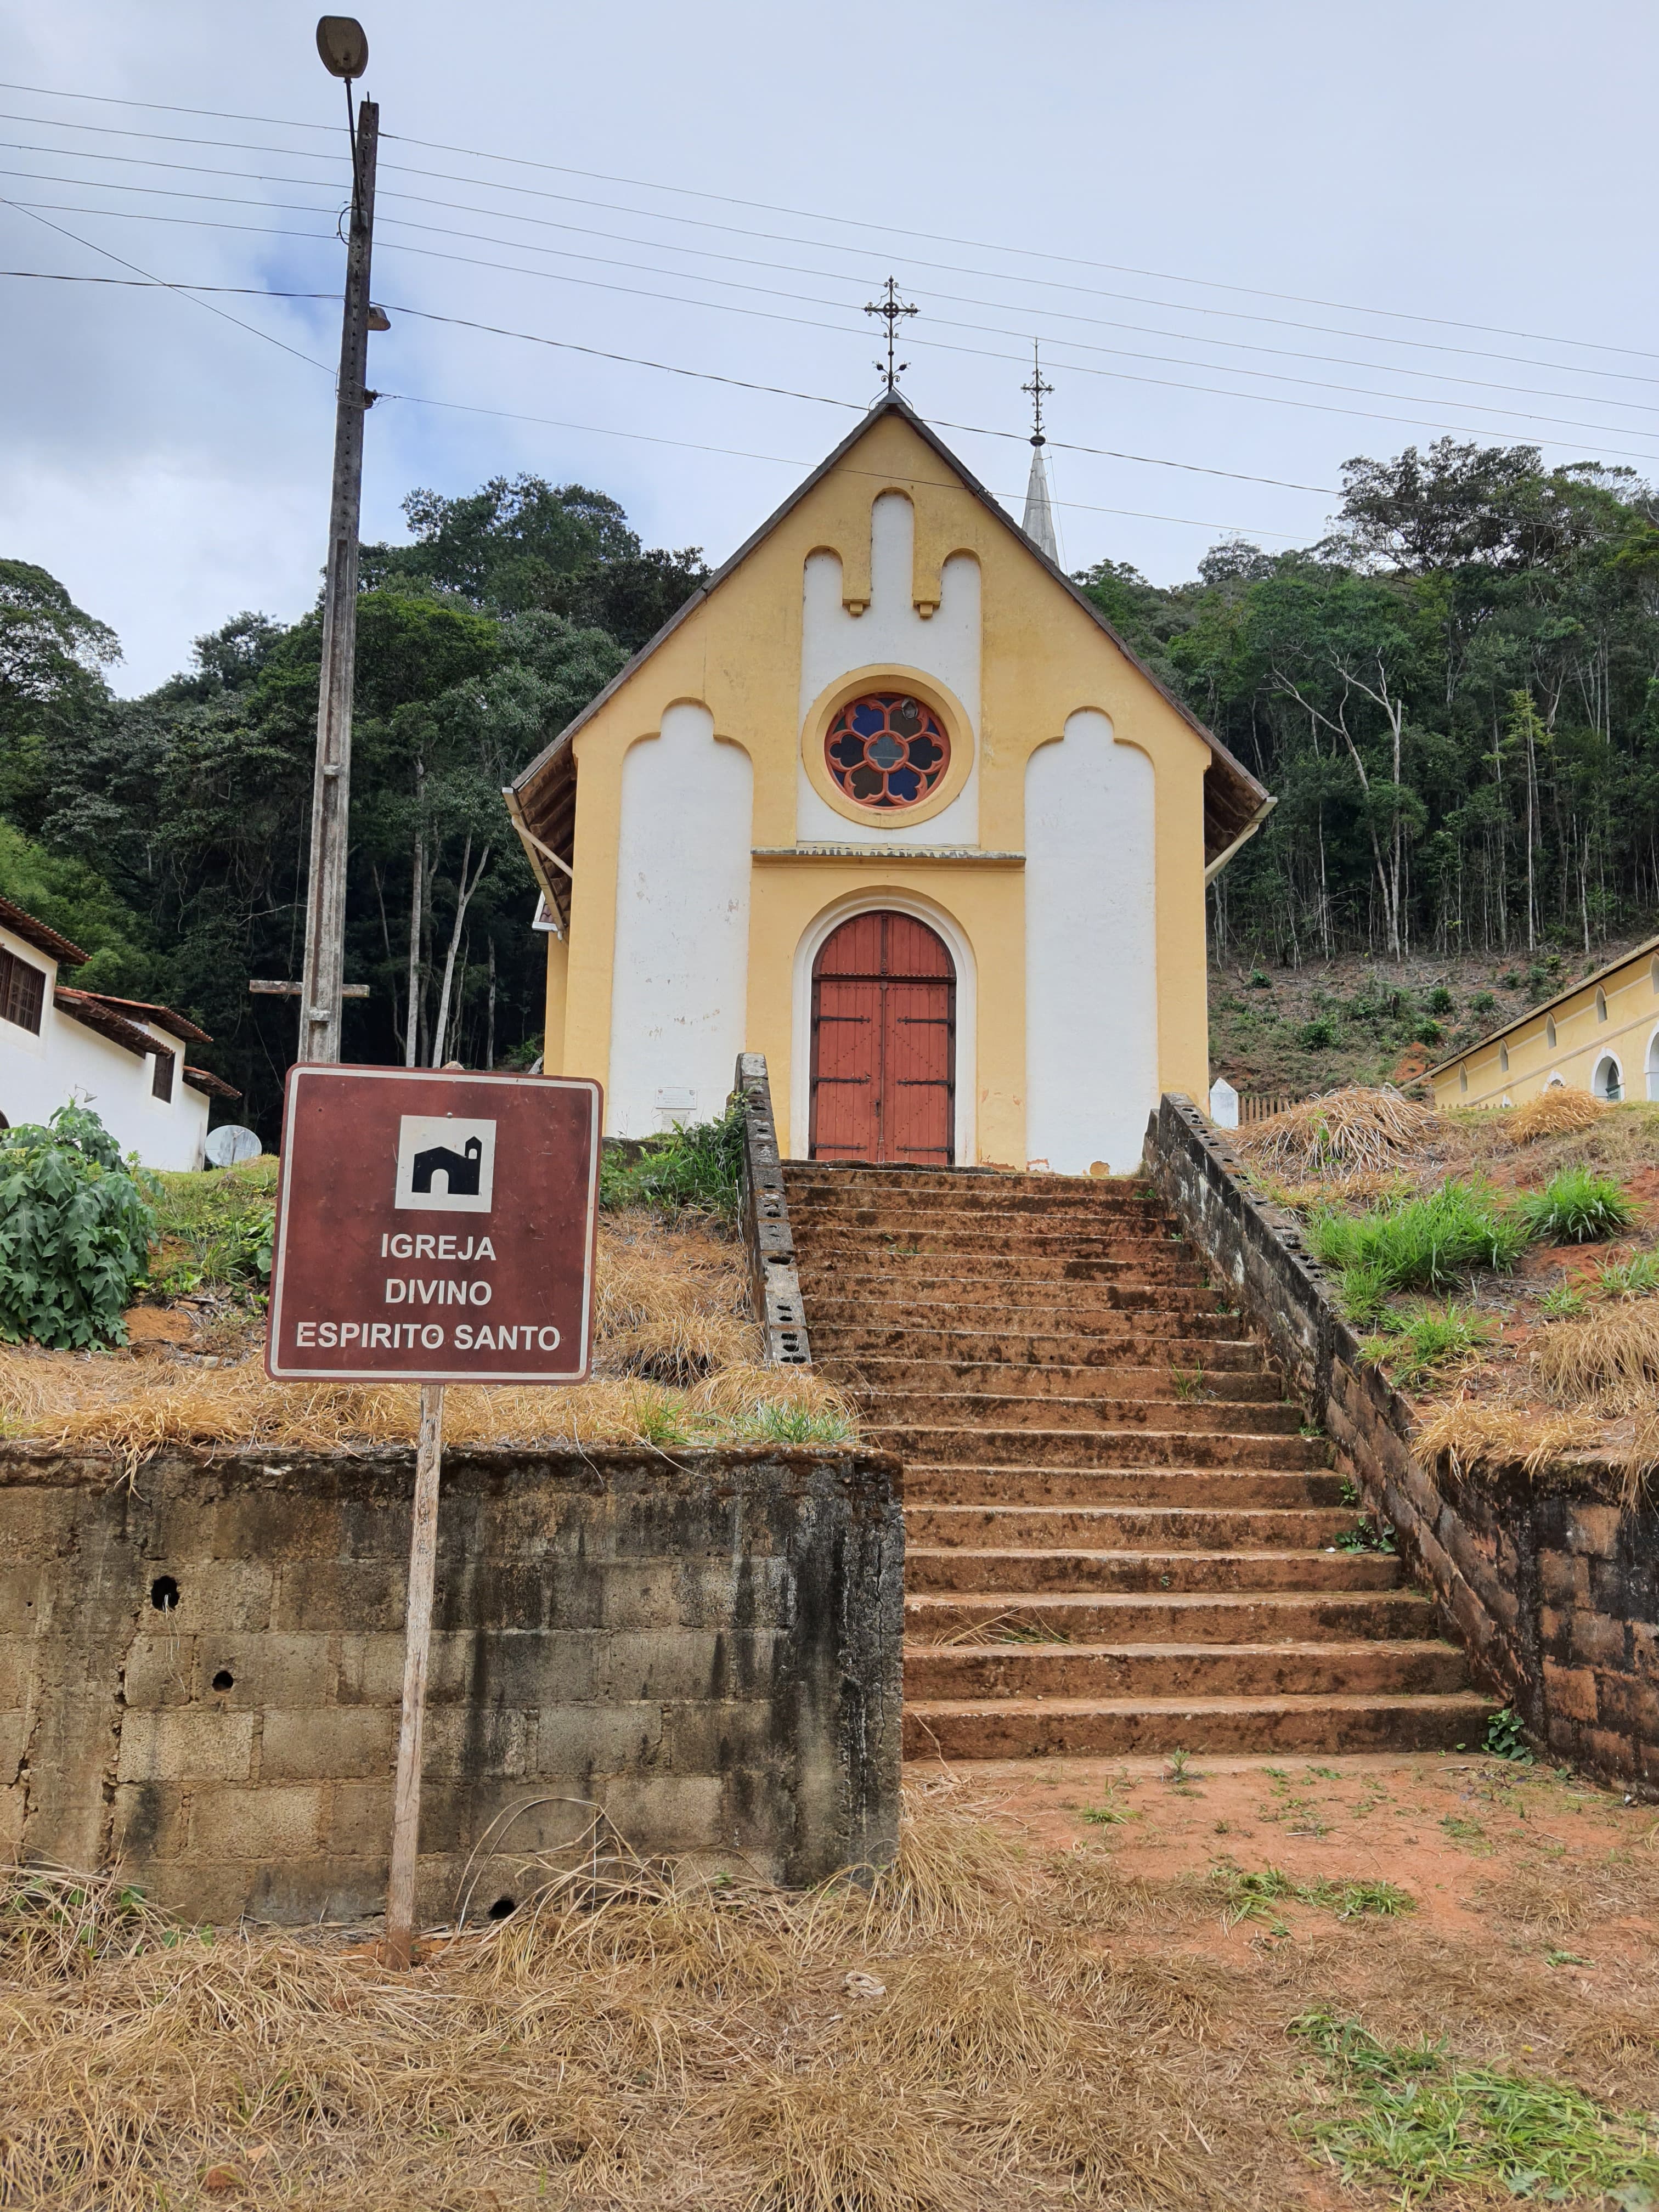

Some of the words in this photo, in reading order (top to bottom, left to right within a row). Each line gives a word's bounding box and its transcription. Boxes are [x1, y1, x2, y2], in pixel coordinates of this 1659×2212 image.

[381, 1233, 496, 1260] IGREJA
[386, 1279, 492, 1306] DIVINO
[296, 1322, 444, 1349] ESPIRITO
[454, 1324, 561, 1351] SANTO
